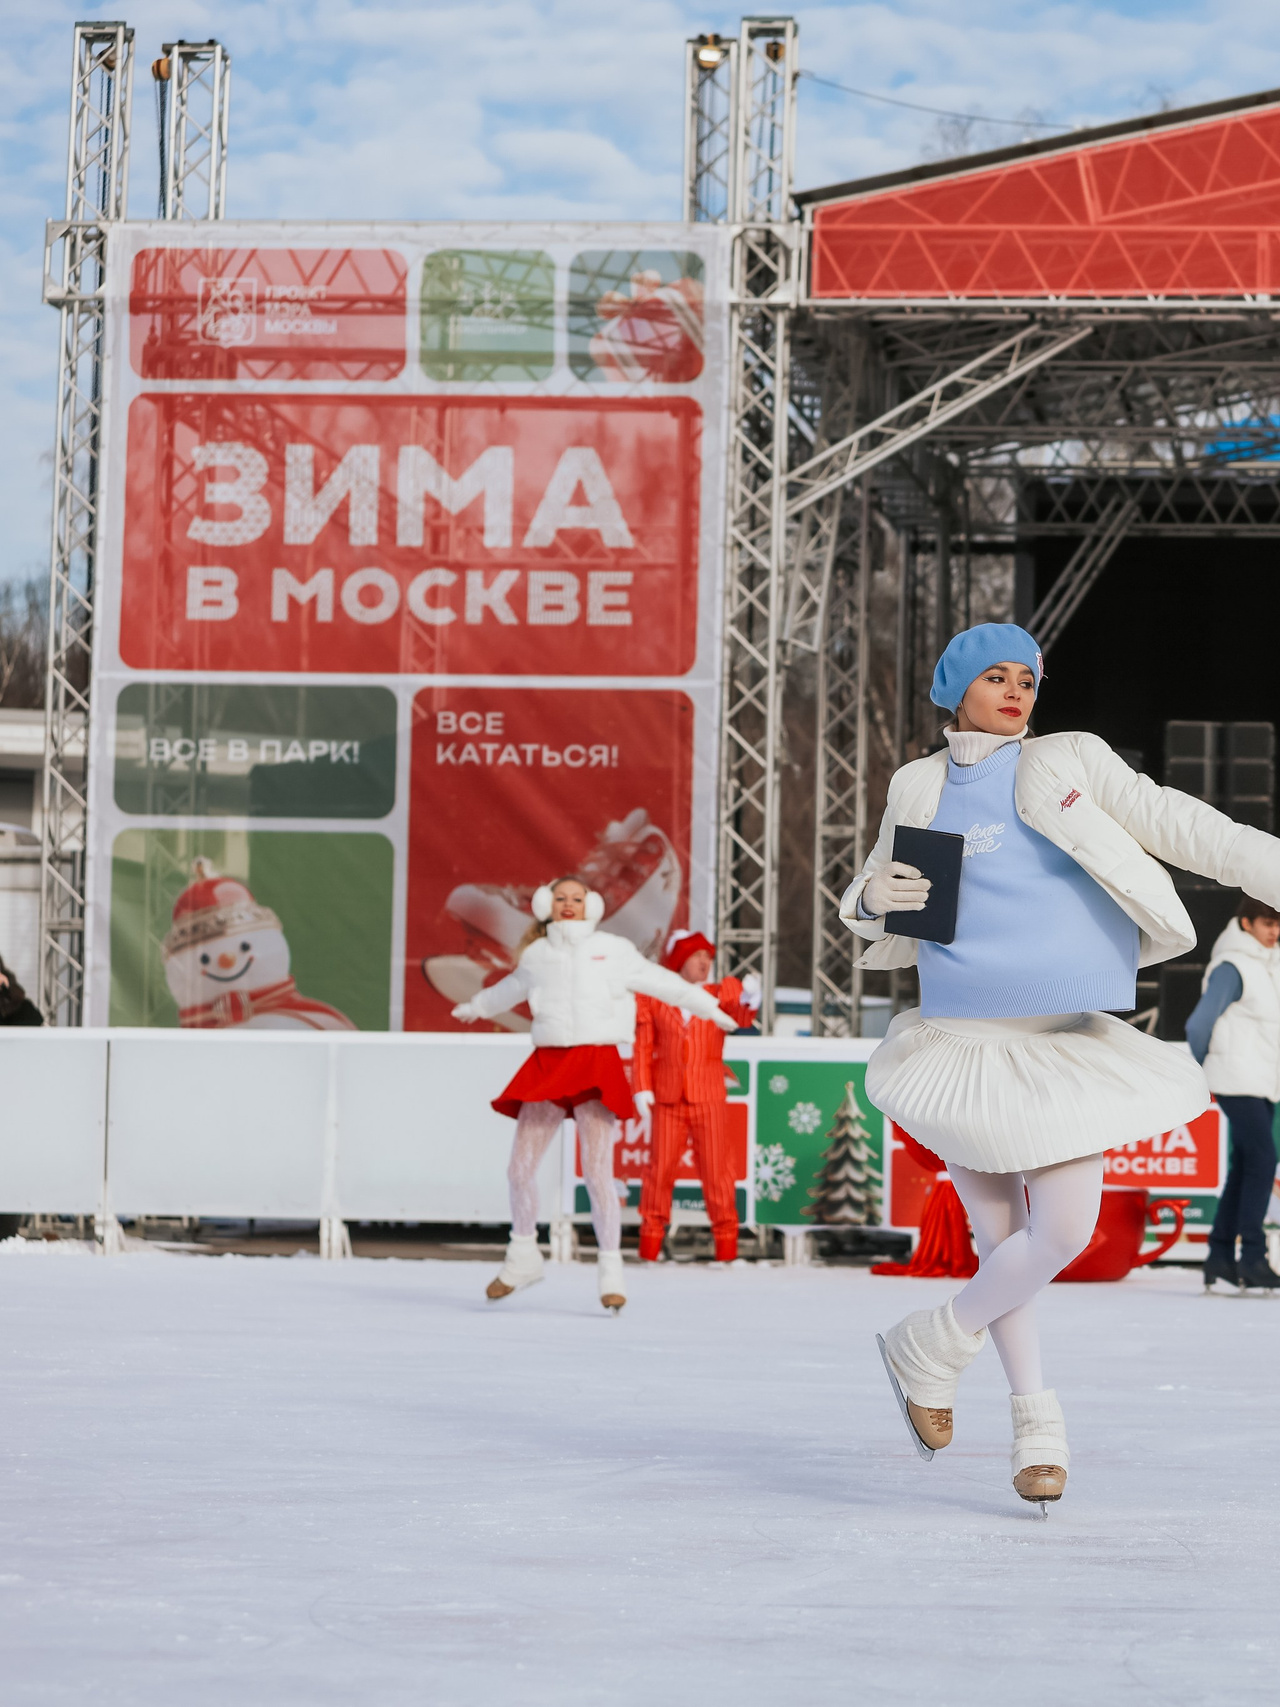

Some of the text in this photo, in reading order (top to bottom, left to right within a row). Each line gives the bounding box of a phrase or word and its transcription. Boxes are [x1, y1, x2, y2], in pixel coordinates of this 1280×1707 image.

[186, 441, 635, 549] ЗИМА
[185, 566, 634, 626] В МОСКВЕ
[436, 710, 505, 735] ВСЕ
[149, 737, 360, 764] ВСЕ В ПАРК!
[436, 742, 619, 768] КАТАТЬСЯ!
